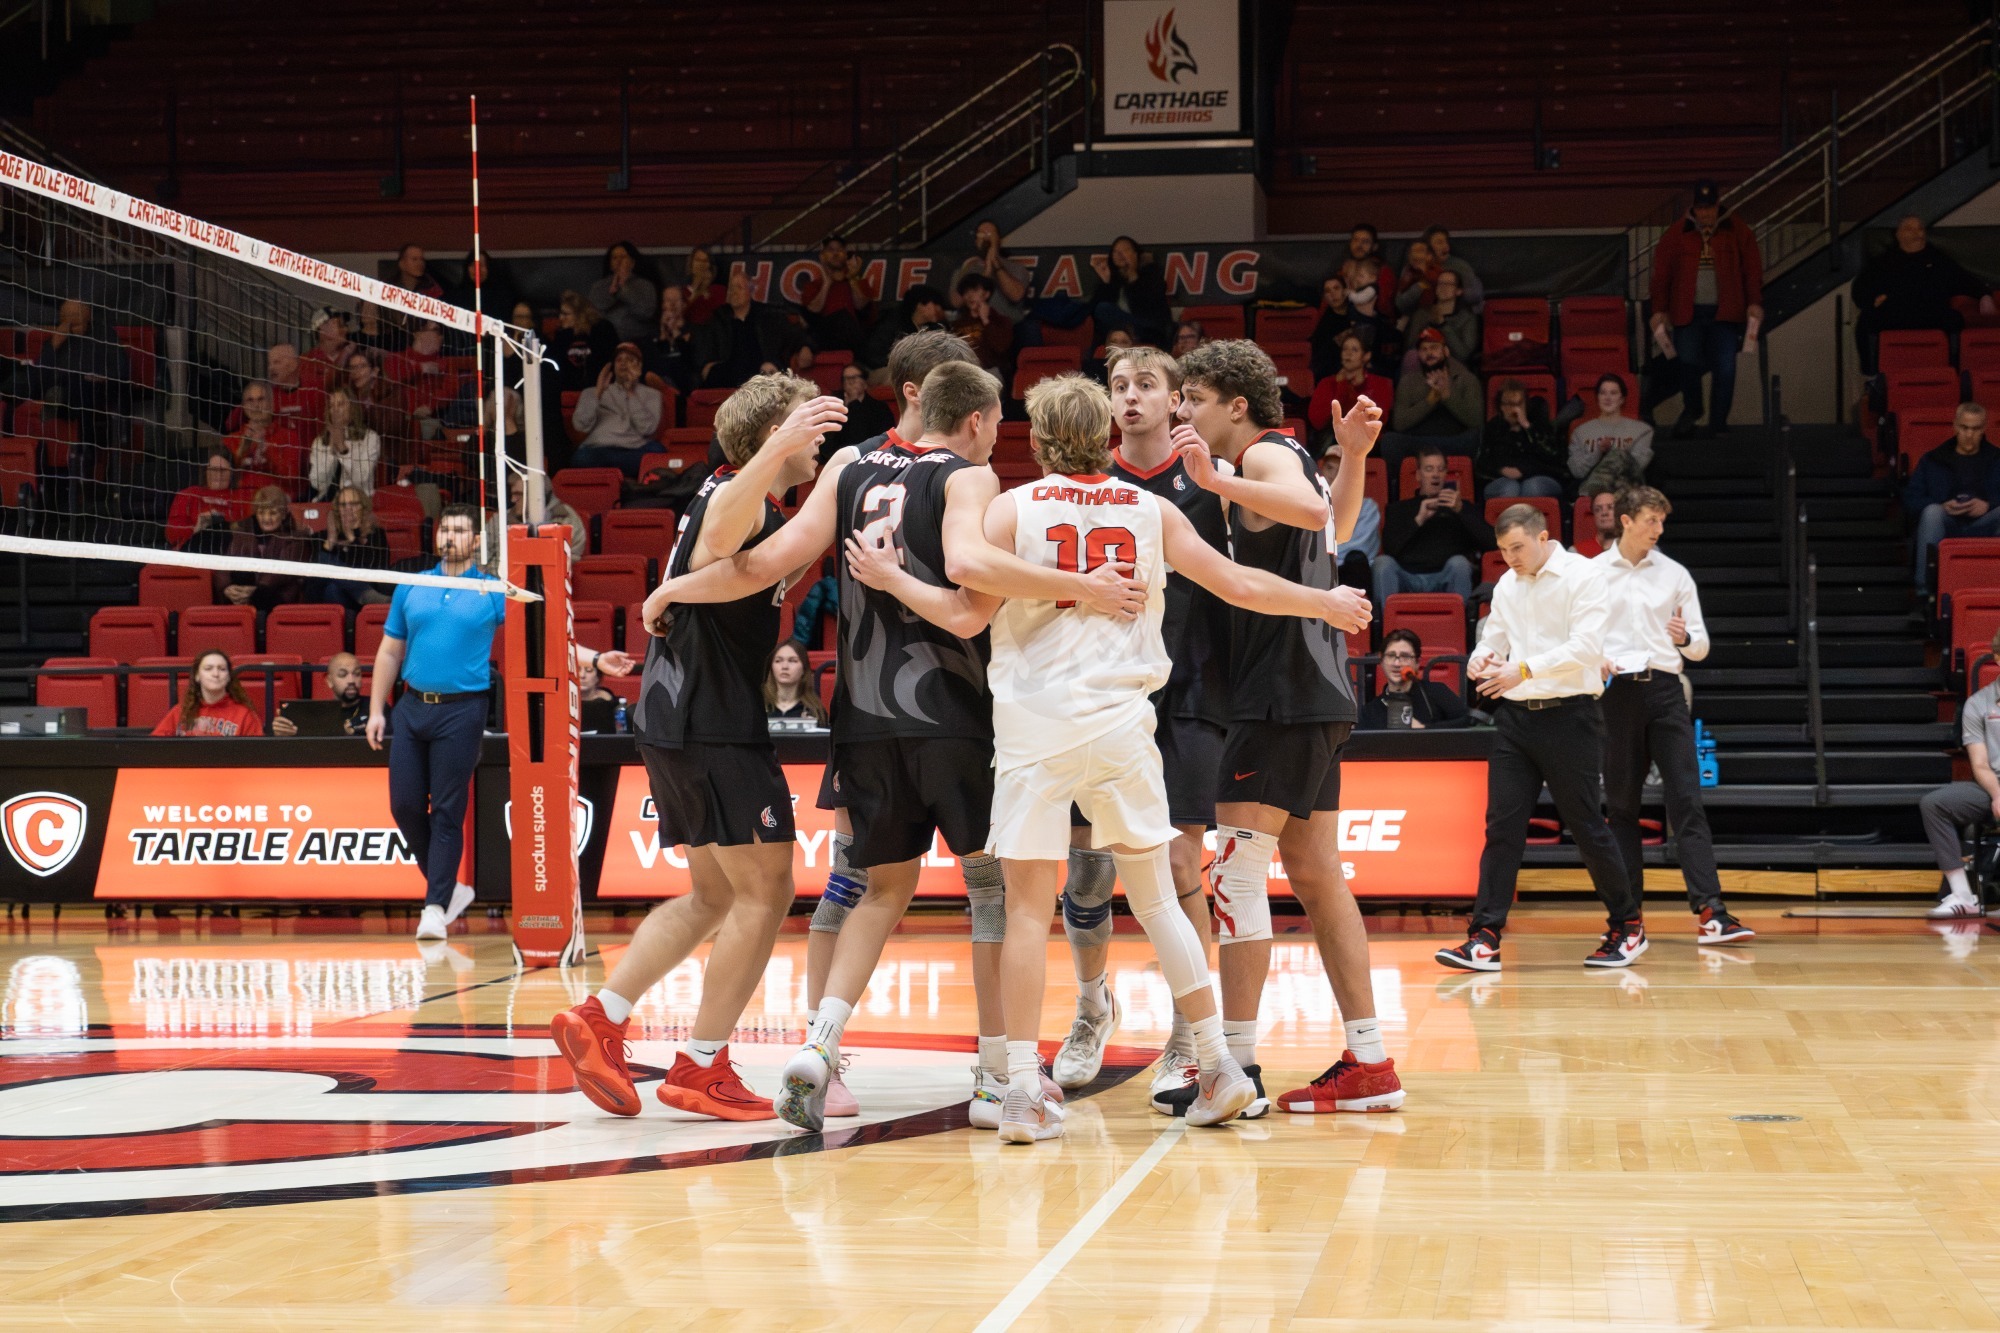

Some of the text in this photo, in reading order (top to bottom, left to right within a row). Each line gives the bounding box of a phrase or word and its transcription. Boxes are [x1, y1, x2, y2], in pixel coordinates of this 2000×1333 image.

[1114, 91, 1228, 110] CARTHAGE
[1131, 110, 1213, 125] FIREBIRDS
[26, 162, 96, 206] VOLLEYBALL
[128, 198, 240, 253] CARTHAGE VOLLEYBALL
[268, 247, 312, 276] CARTHAGE
[1032, 486, 1139, 506] CARTHAGE
[143, 805, 313, 822] WELCOME TO
[530, 785, 546, 833] sports
[26, 809, 64, 857] C
[129, 829, 418, 864] TARBLE AREN
